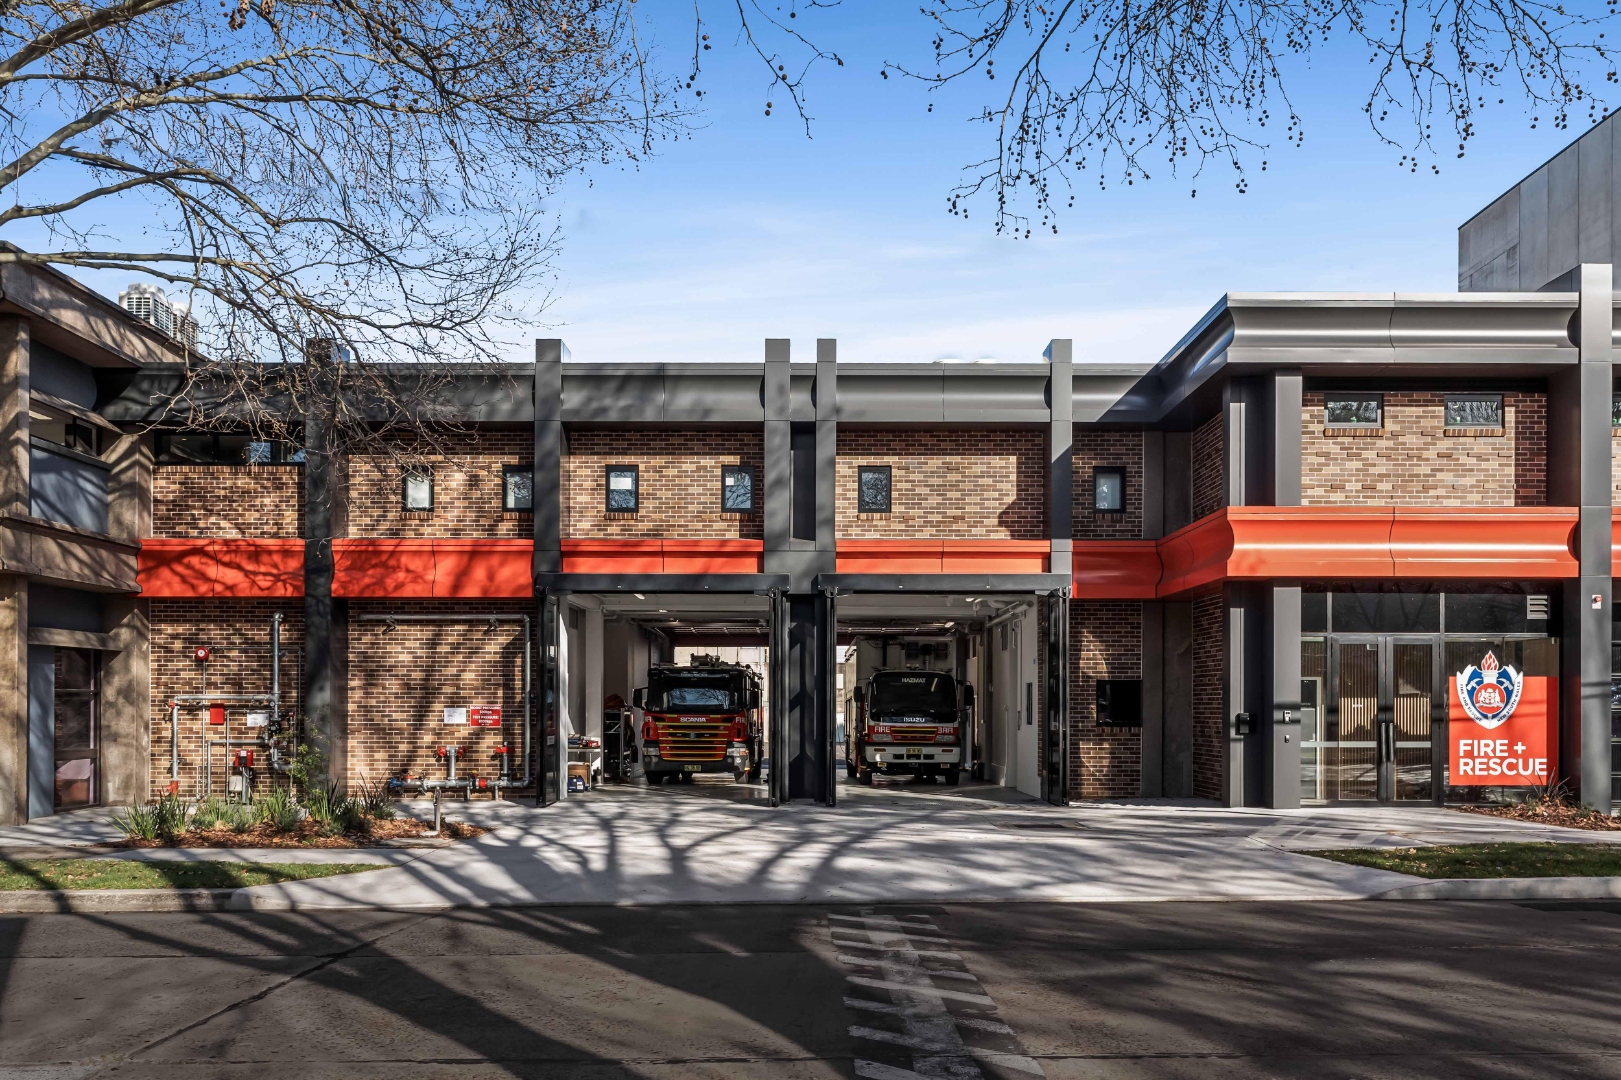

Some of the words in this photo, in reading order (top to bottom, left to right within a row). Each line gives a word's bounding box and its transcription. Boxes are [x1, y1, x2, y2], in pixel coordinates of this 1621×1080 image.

[1459, 739, 1508, 757] FIRE
[1513, 741, 1526, 754] +
[1459, 758, 1548, 776] RESCUE
